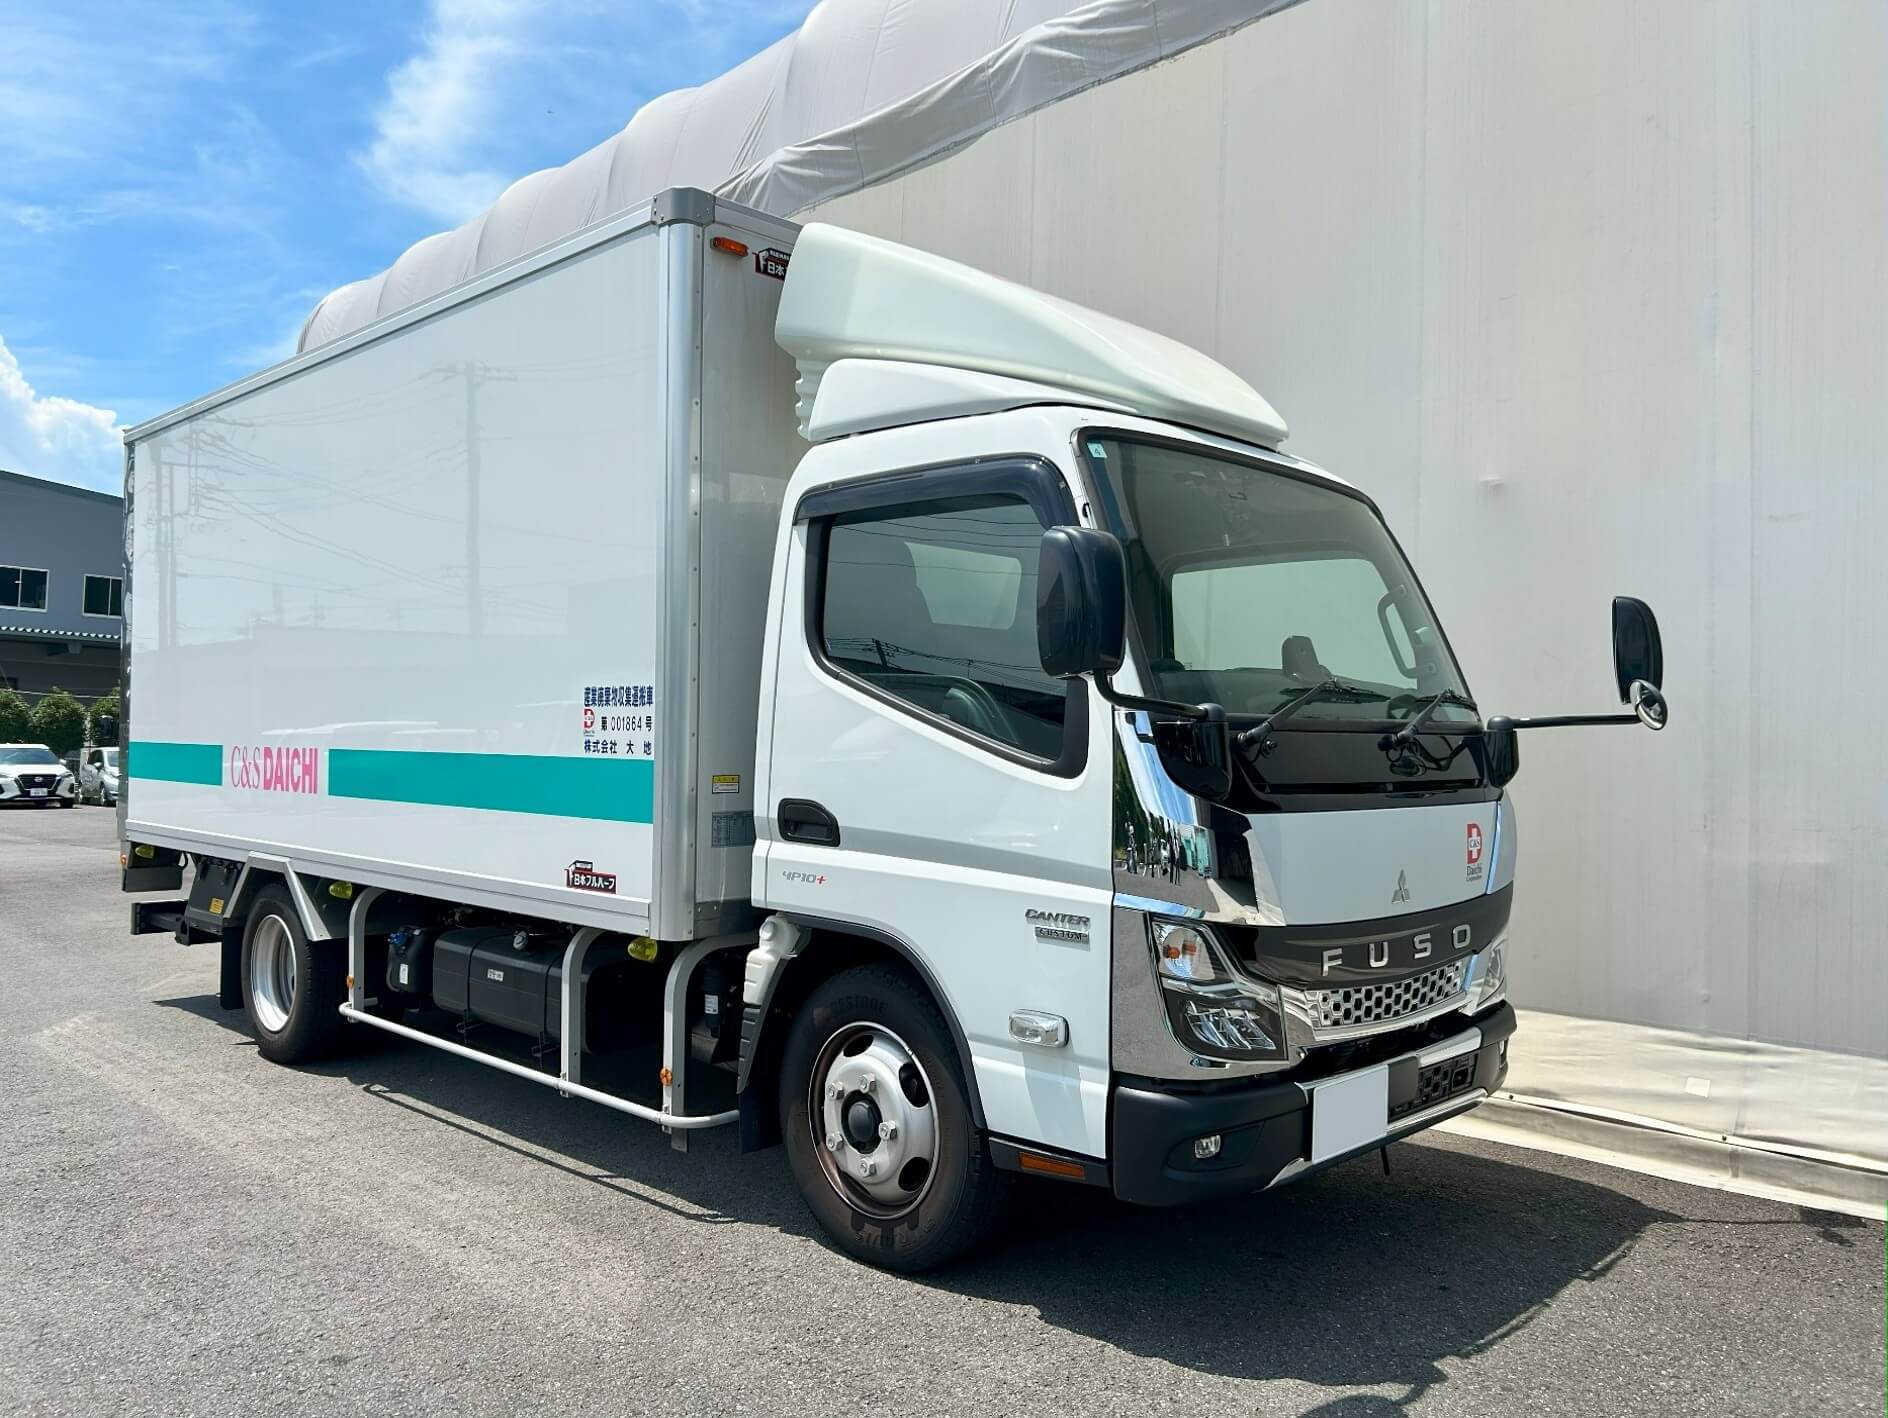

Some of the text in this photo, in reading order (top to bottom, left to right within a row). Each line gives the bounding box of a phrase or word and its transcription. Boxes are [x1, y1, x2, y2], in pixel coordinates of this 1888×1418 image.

[573, 873, 615, 890] 日本フルハーフ
[1025, 908, 1090, 927] CANTER
[1321, 924, 1471, 977] FUSO
